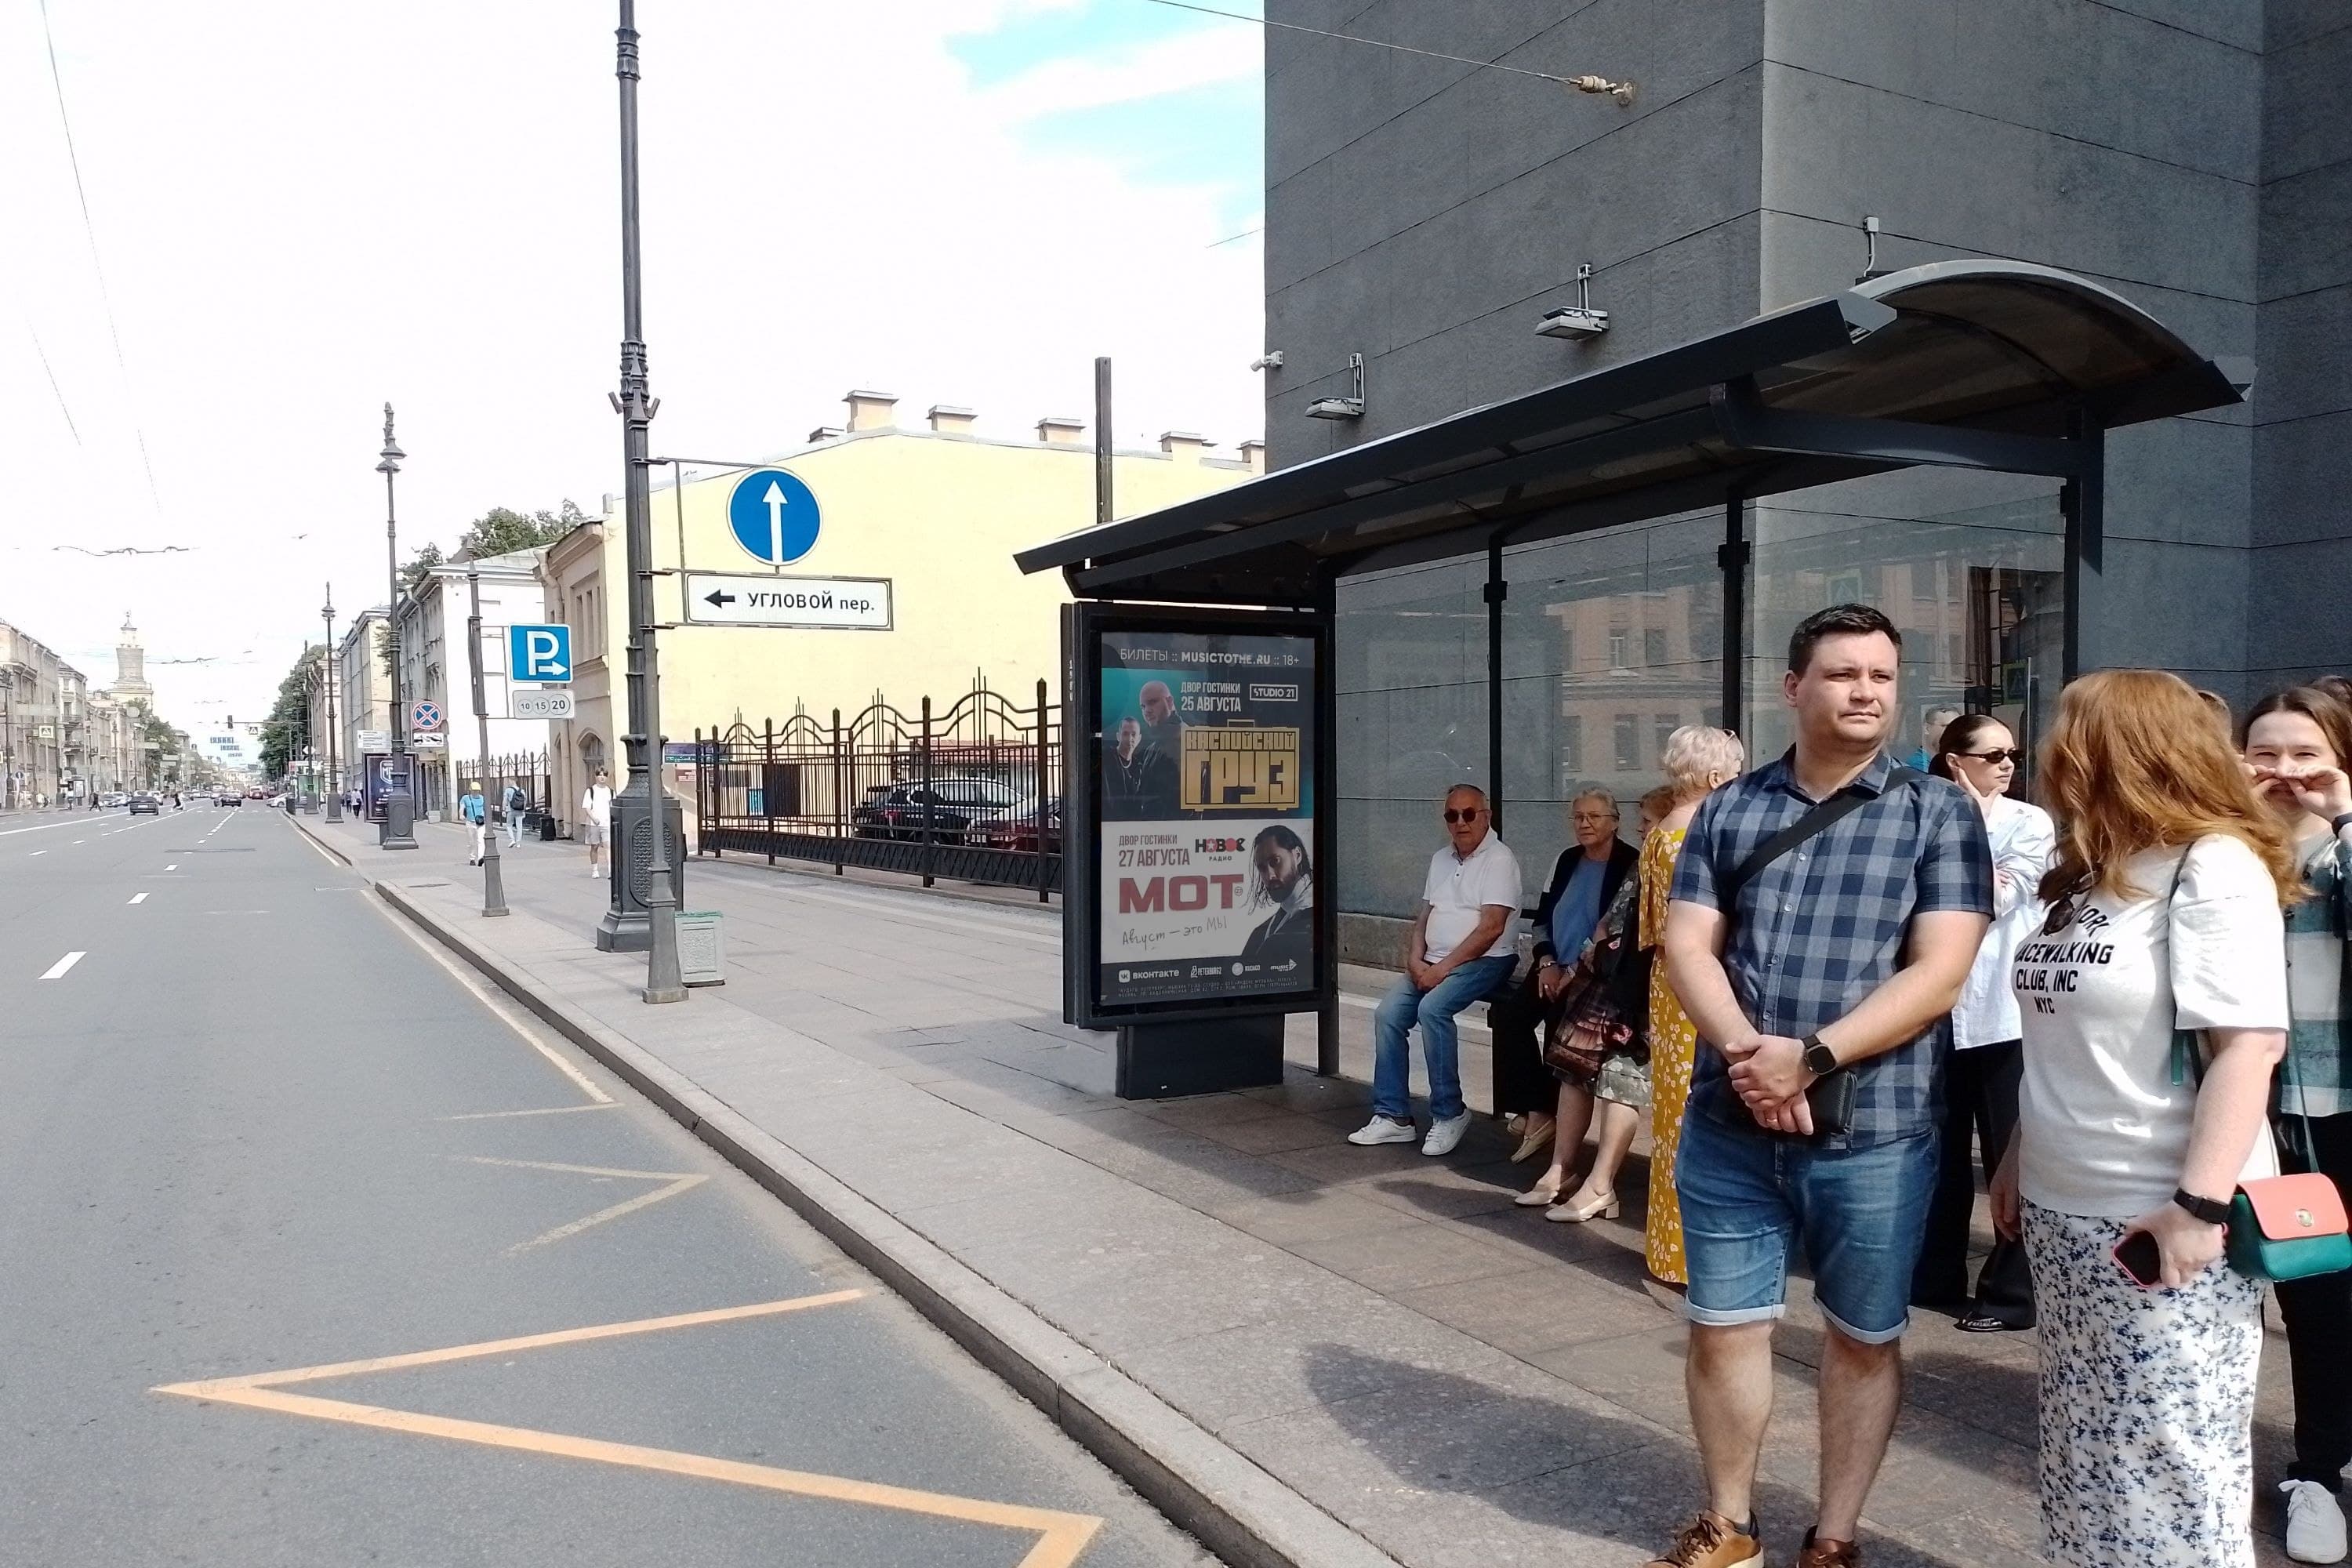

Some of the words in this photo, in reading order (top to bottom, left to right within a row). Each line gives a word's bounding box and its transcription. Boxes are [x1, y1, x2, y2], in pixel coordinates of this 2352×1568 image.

[747, 590, 833, 609] УГЛОВОЙ
[840, 599, 875, 614] пер.
[1120, 648, 1168, 662] БИЛЕТЫ
[1181, 652, 1271, 665] MUSICTOTHE.RU
[1283, 655, 1299, 666] 18+
[1181, 681, 1202, 694] ДВОР
[1203, 682, 1240, 694] ГОСТИНКИ
[1254, 688, 1284, 697] STUDIO
[1286, 688, 1294, 698] 21
[535, 702, 546, 710] 15
[552, 700, 565, 710] 20
[1181, 695, 1194, 711] 25
[1196, 696, 1242, 712] АВГУСТА
[1185, 750, 1295, 804] ГРУЗ
[1119, 835, 1139, 847] ДВОР
[1140, 834, 1178, 846] ГОСТИНКИ
[1119, 849, 1134, 867] 27
[1137, 848, 1190, 867] АВГУСТА
[1119, 873, 1244, 914] МОТ
[1122, 928, 1166, 951] Август
[1183, 926, 1203, 936] это
[1207, 915, 1227, 931] МЫ
[1132, 969, 1180, 979] вконтакте
[2016, 968, 2049, 993] CLUB,
[2053, 969, 2078, 993] INC
[2034, 996, 2056, 1014] NYC
